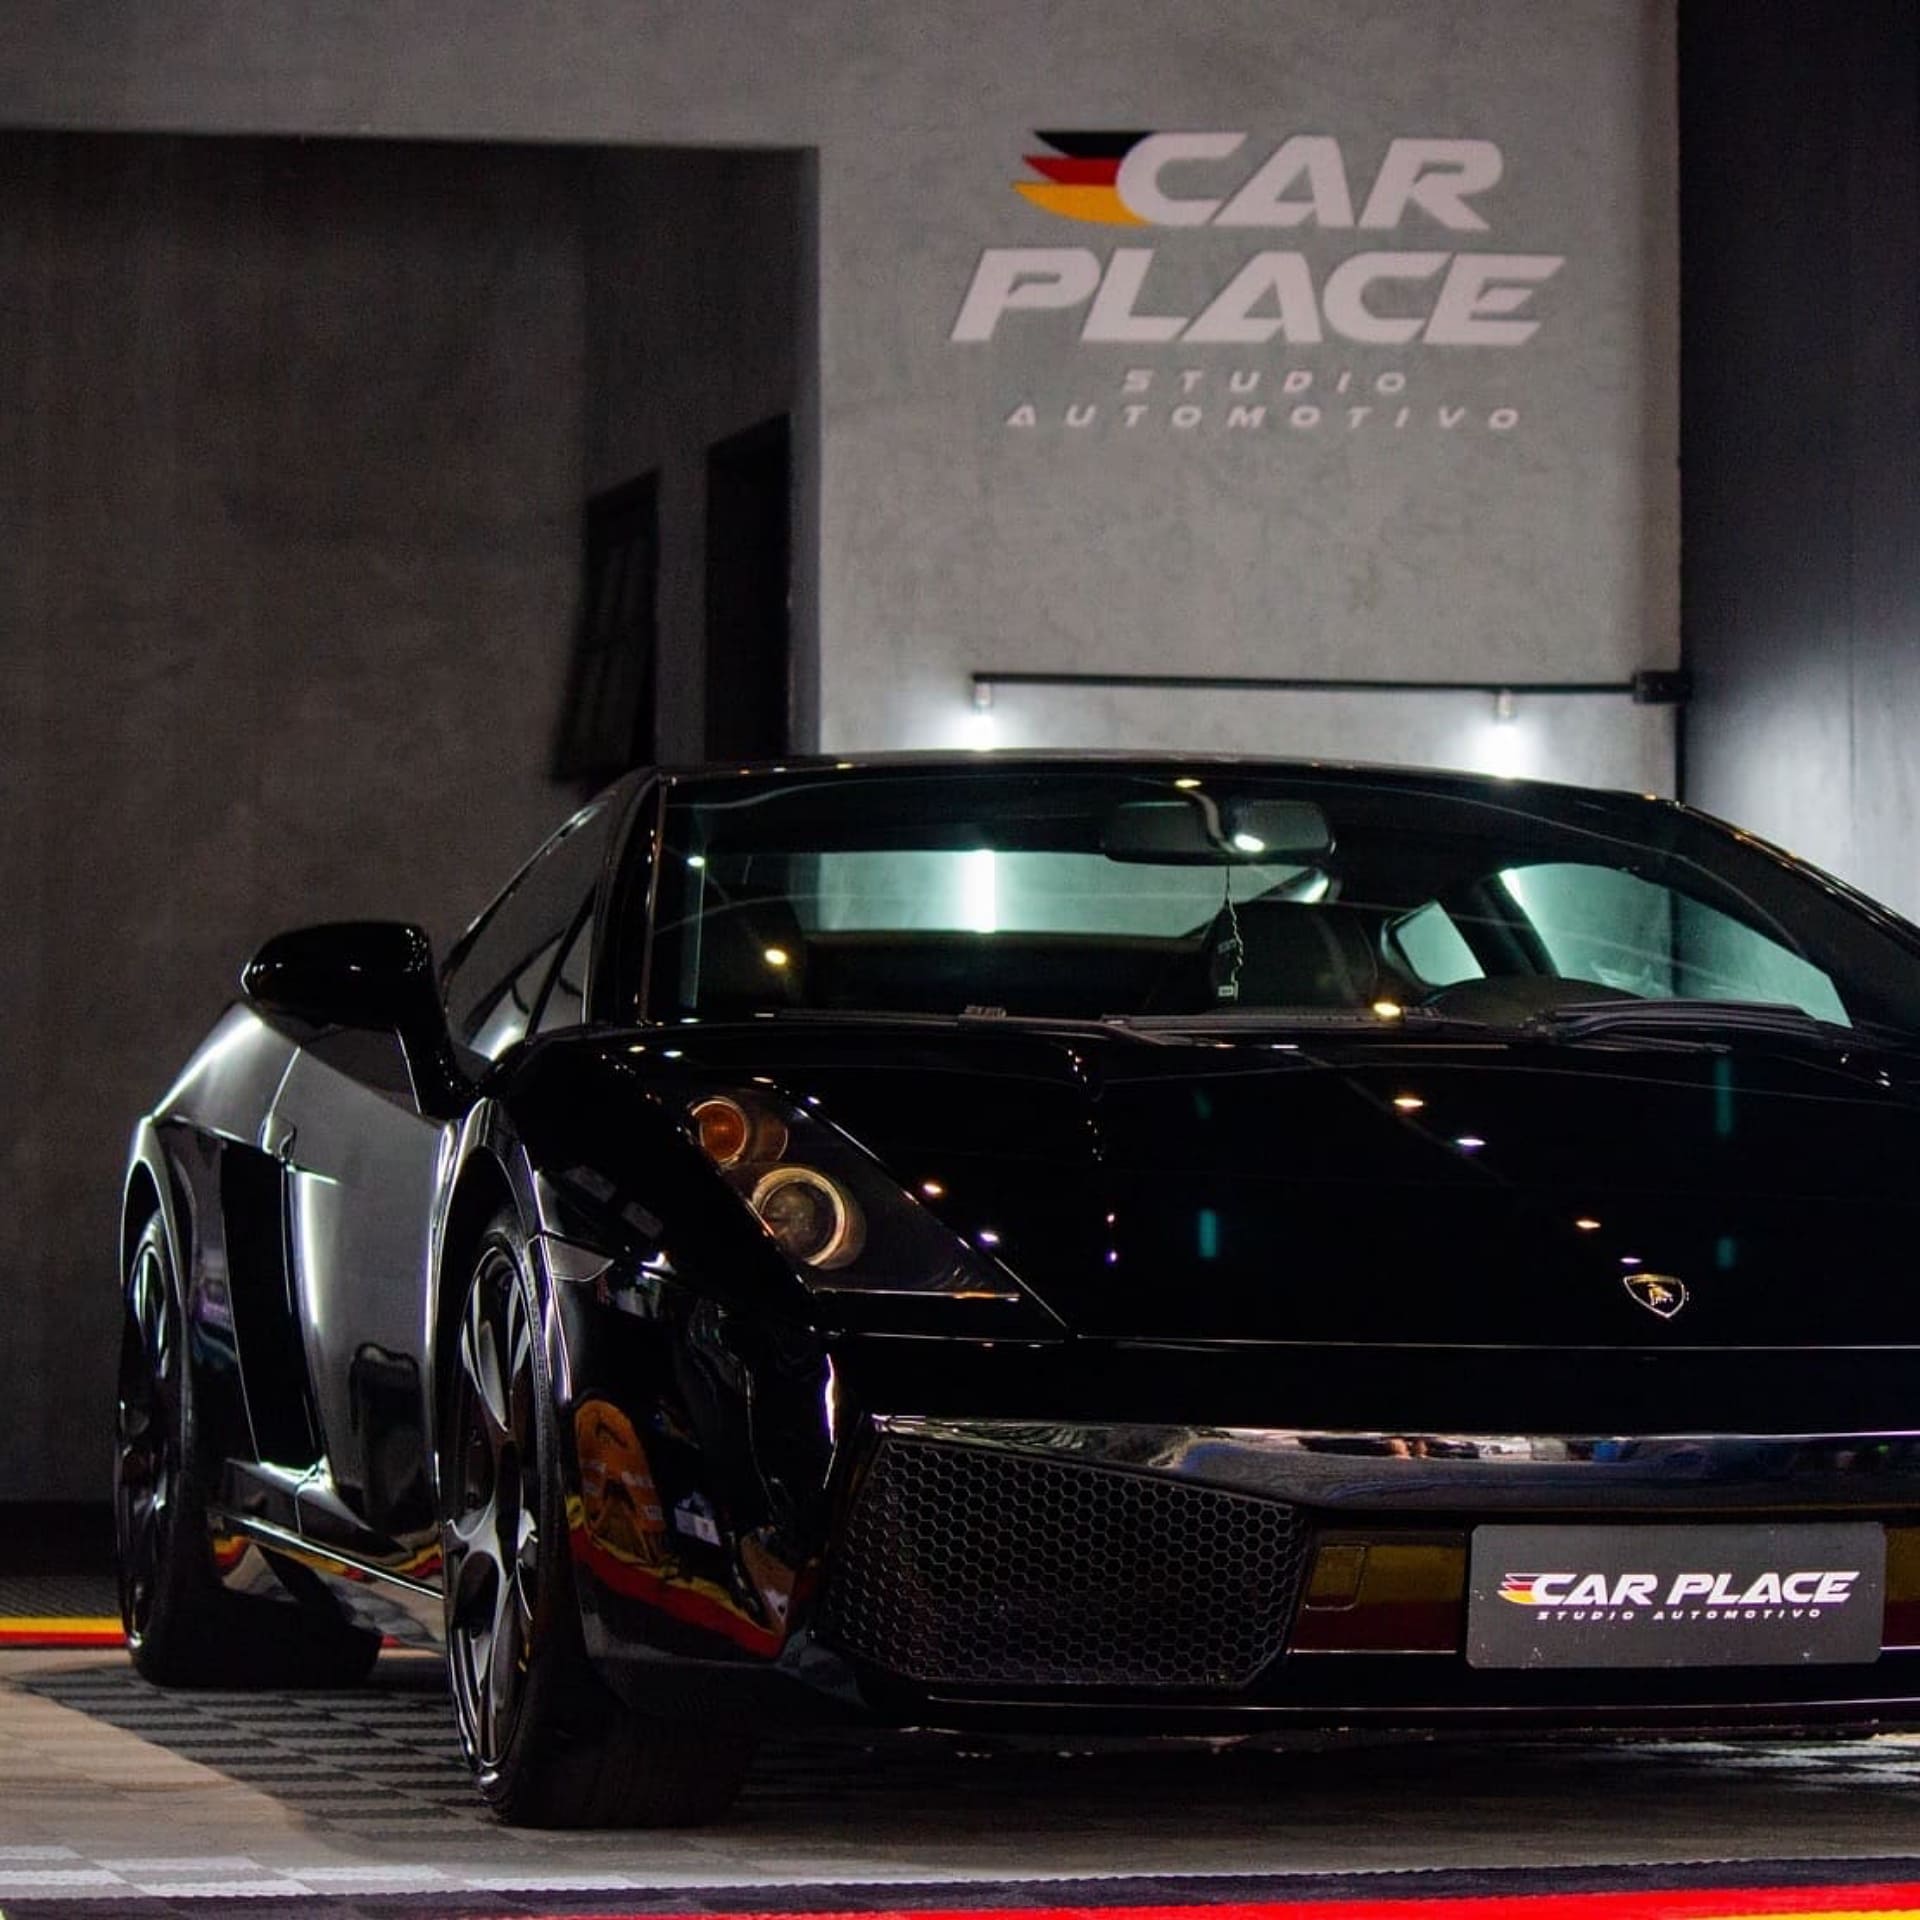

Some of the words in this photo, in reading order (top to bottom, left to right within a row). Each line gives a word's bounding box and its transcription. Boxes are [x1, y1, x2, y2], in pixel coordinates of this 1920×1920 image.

[1116, 132, 1503, 231] CAR
[950, 247, 1566, 345] PLACE
[1122, 369, 1408, 395] STUDIO
[1007, 405, 1520, 430] AUTOMOTIVO
[1530, 1574, 1658, 1605] CAR
[1666, 1572, 1860, 1605] PLACE
[1536, 1611, 1634, 1620] STUDIO
[1653, 1609, 1821, 1620] AUTOMOTIVO
